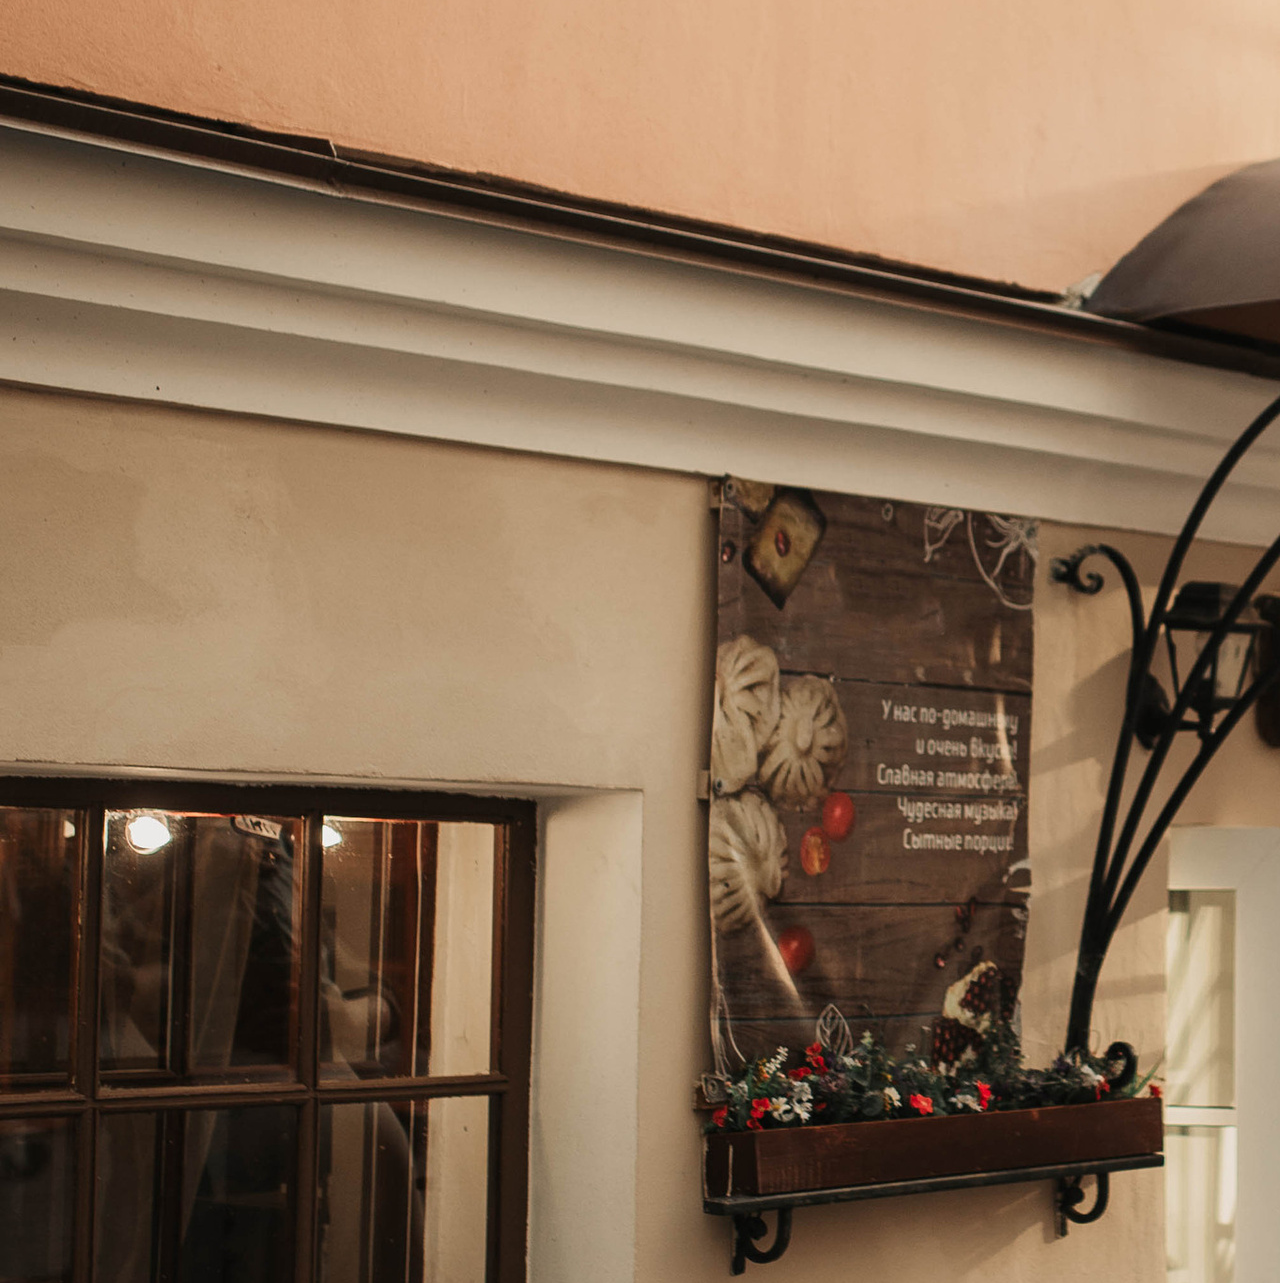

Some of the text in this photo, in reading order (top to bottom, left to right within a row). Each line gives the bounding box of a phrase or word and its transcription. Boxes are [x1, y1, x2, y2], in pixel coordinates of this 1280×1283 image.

[881, 699, 1018, 735] У нас по-домашну
[915, 736, 1017, 764] и очень вкус!
[877, 763, 934, 786] Славная
[897, 796, 962, 823] Чудесная
[903, 828, 962, 850] Сытные
